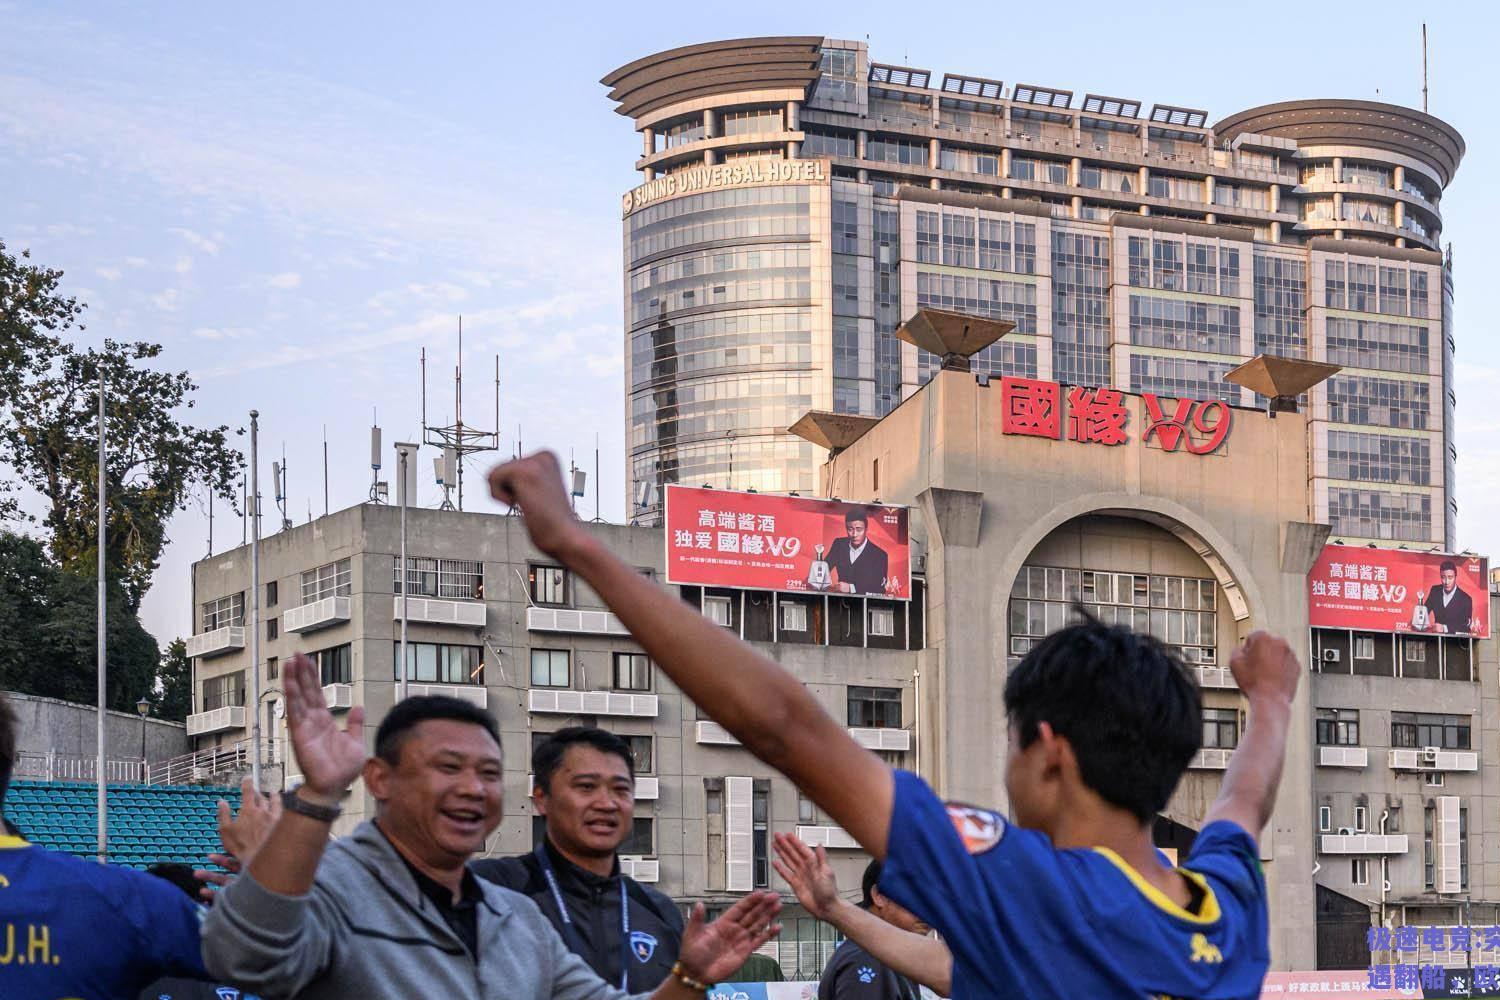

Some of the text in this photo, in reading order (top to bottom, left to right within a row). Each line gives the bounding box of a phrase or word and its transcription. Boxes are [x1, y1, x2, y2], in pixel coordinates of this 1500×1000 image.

[635, 160, 825, 207] SUNING UNIVERSAL HOTEL
[698, 509, 776, 533] 高端酱酒
[674, 529, 713, 550] 独爱
[1329, 562, 1388, 582] 高端酱酒
[1312, 580, 1341, 597] 独爱
